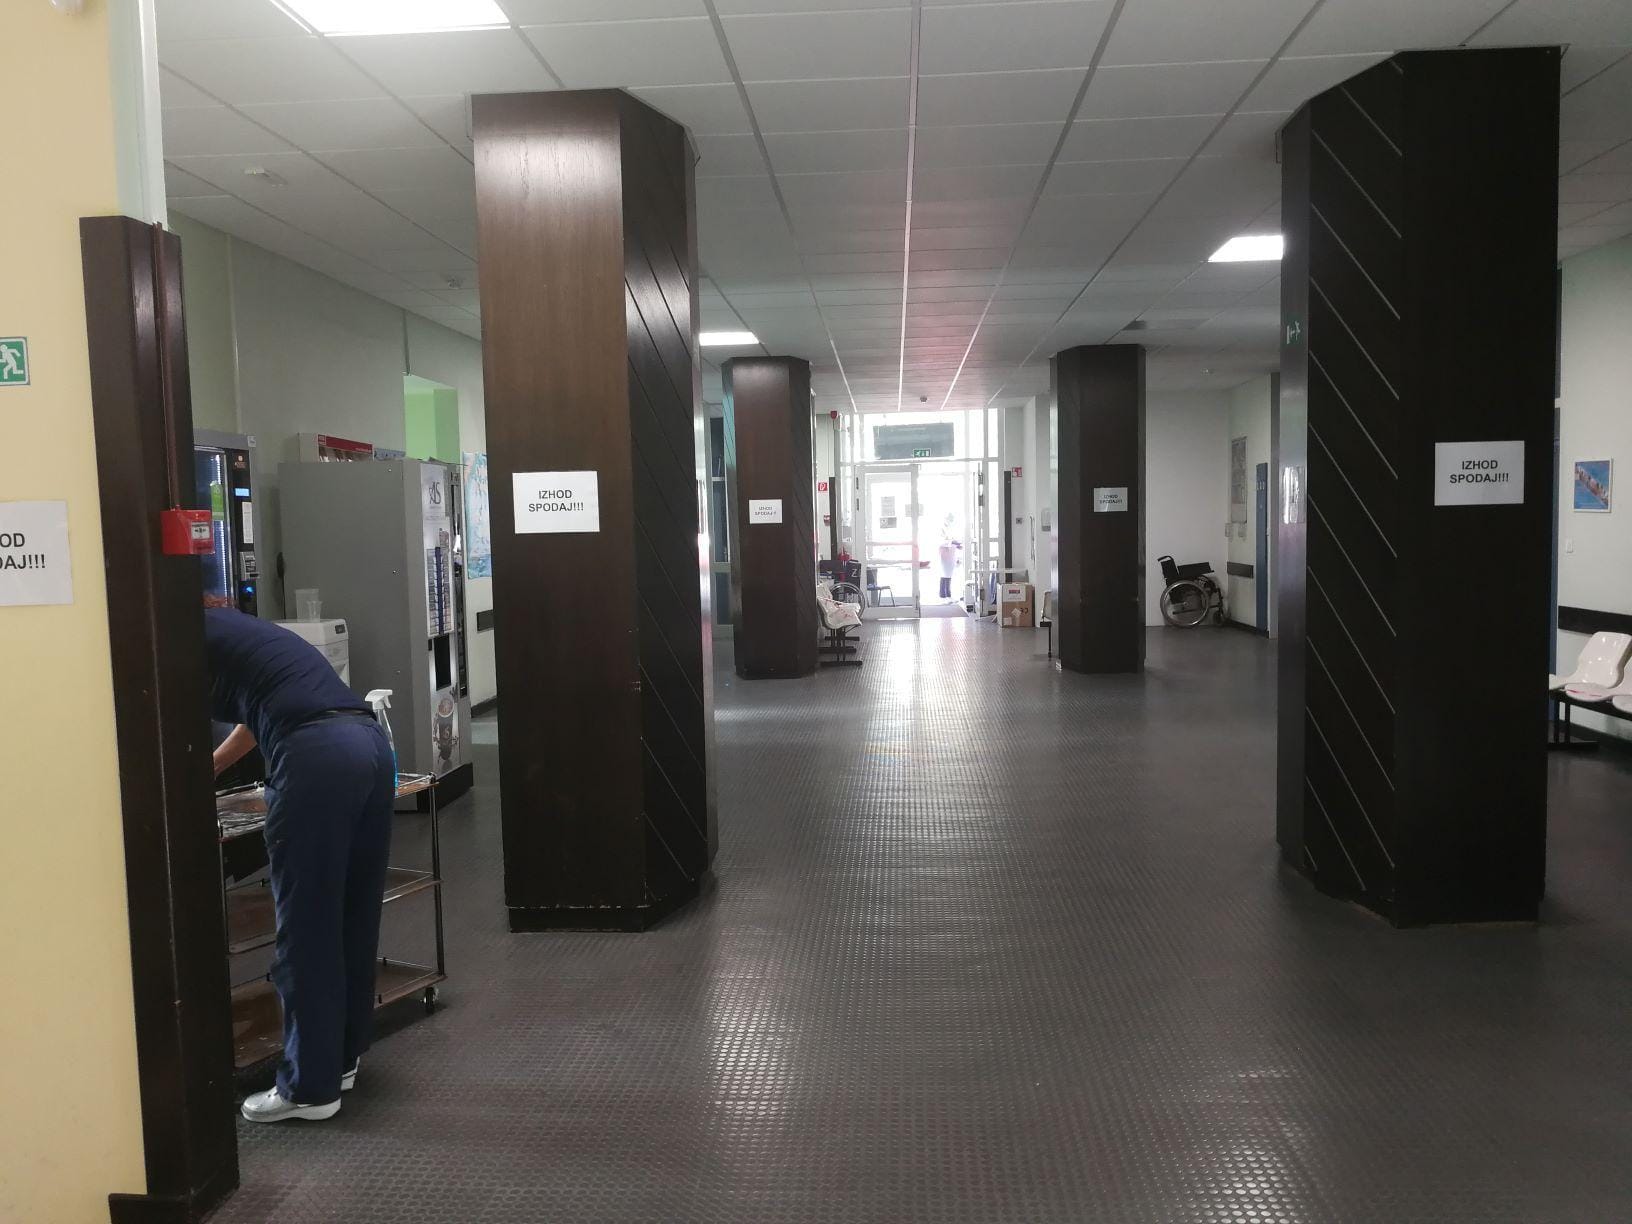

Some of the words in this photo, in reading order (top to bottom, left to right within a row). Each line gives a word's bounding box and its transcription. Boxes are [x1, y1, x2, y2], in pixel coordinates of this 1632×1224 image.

[1462, 459, 1498, 470] IZHOD
[1449, 473, 1509, 484] SPODAJ!!!
[538, 489, 573, 499] IZHOD
[528, 502, 584, 512] SPODAJ!!!
[0, 554, 46, 570] AJ!!!
